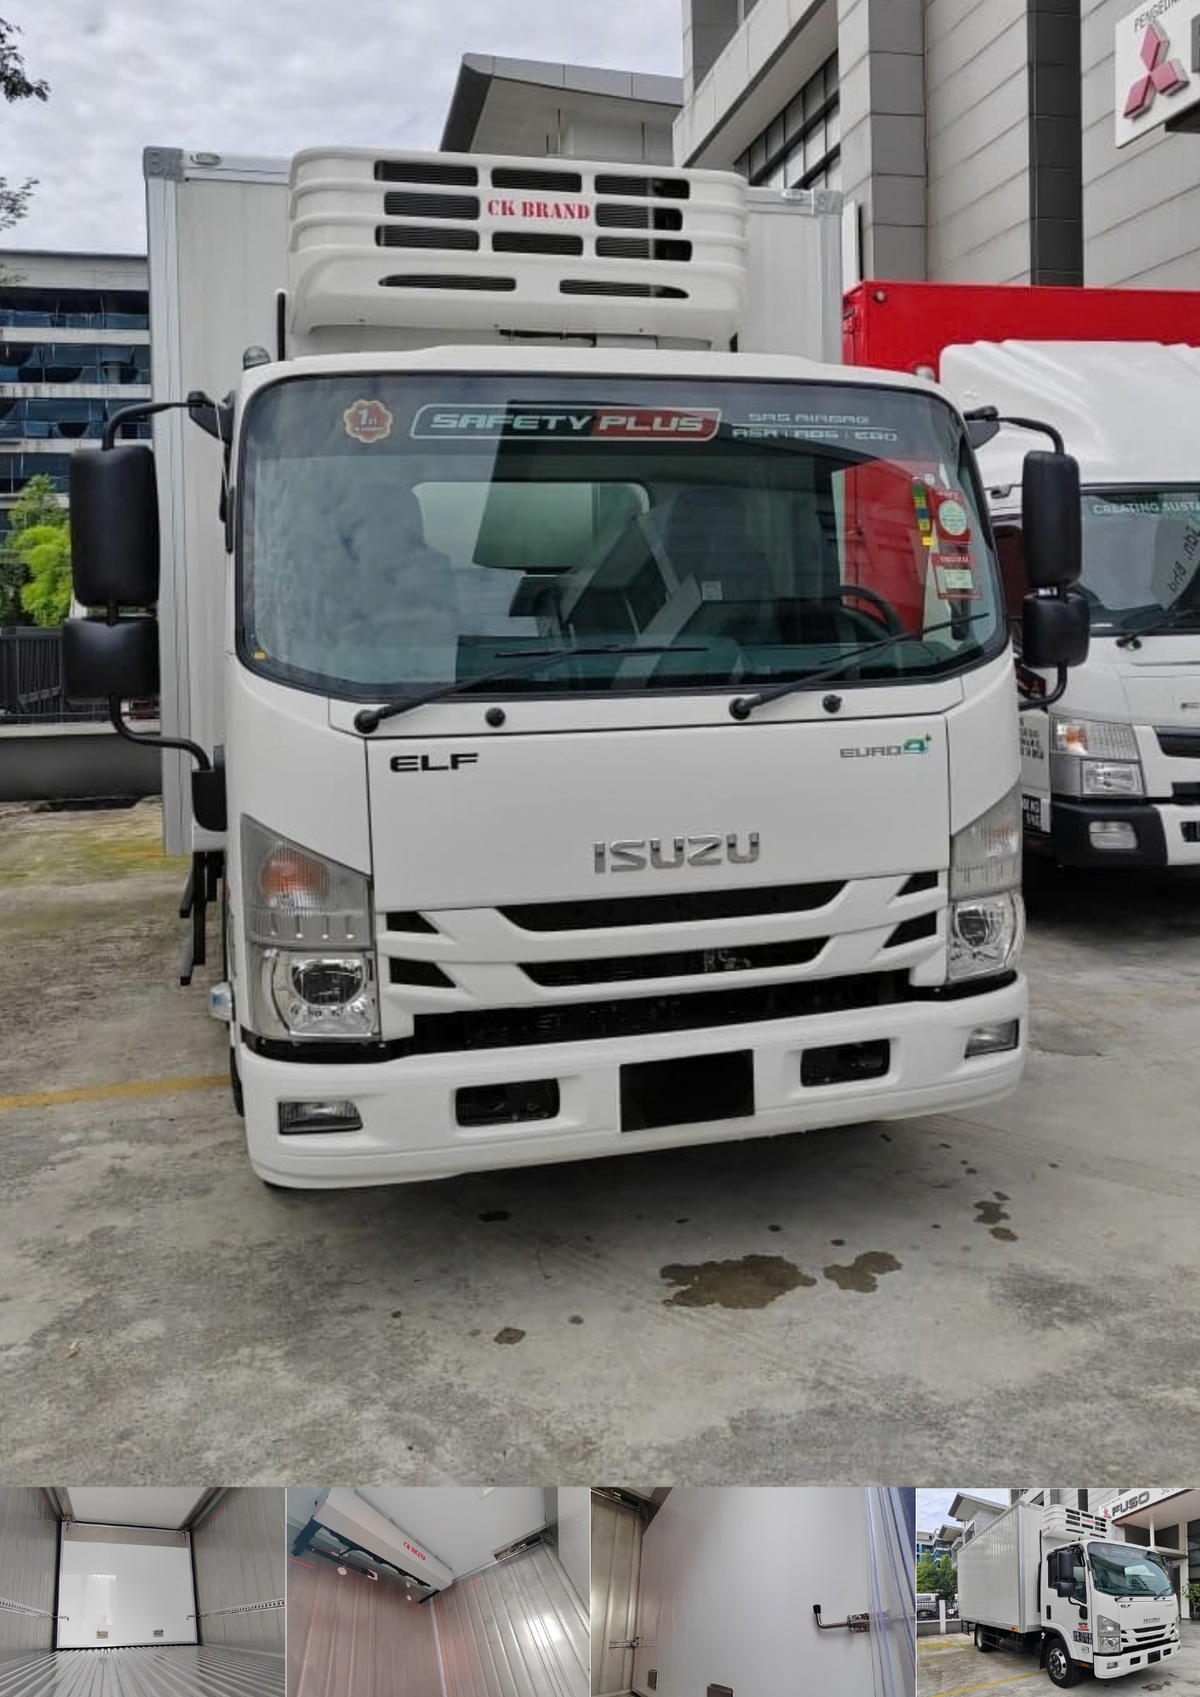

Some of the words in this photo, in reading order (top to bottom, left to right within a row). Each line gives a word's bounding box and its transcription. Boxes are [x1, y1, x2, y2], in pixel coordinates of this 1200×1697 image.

[487, 200, 515, 216] CK
[521, 201, 591, 220] BRAND
[431, 413, 592, 431] SAFETY
[599, 415, 704, 432] PLUS
[748, 413, 790, 422] SRS
[794, 414, 870, 424] AIRBAG
[732, 428, 777, 439] ASR
[1092, 503, 1159, 514] CREATING
[390, 752, 479, 773] ELF
[594, 832, 760, 874] ISUZU
[1111, 1490, 1150, 1517] FUSO
